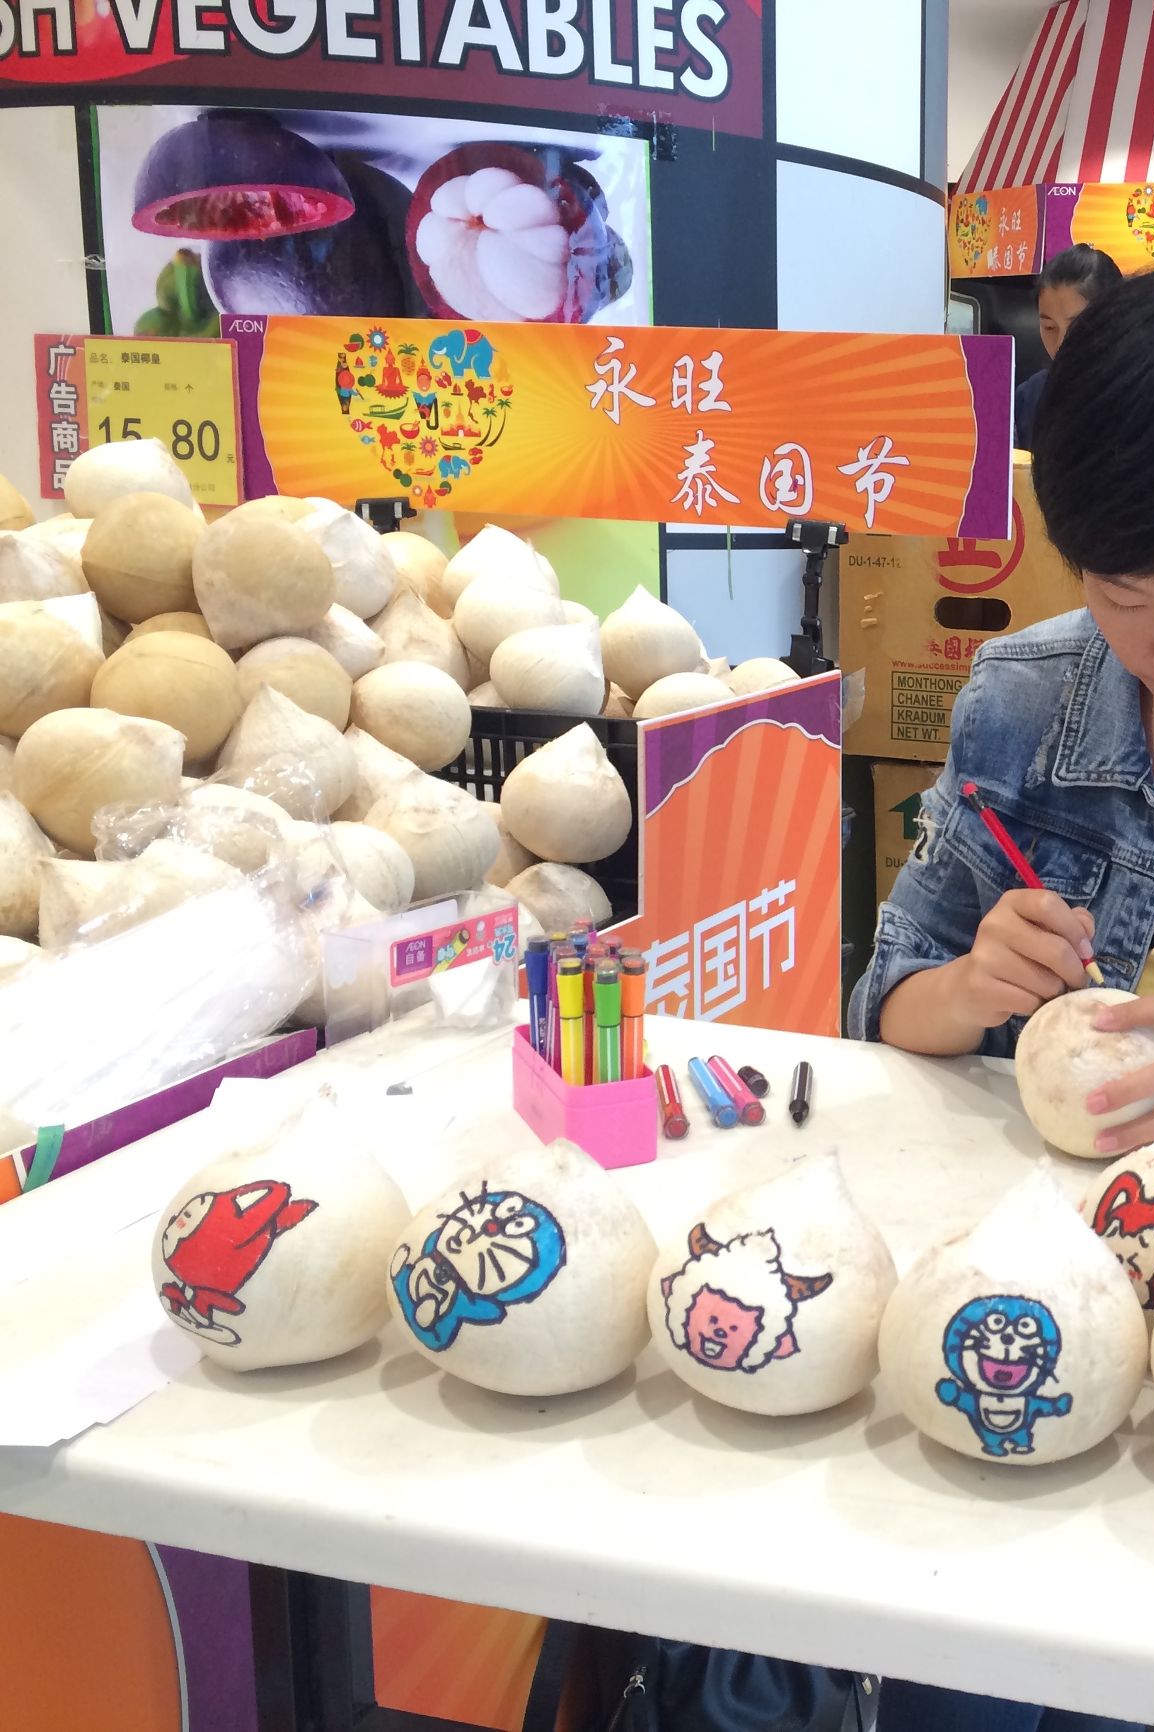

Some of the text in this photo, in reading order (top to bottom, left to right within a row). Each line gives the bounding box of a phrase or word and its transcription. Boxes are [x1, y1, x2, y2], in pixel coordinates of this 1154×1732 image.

[112, 0, 729, 99] VEGETABLES
[998, 207, 1022, 237] 永旺
[585, 336, 733, 425] 永旺
[670, 429, 911, 528] 泰国节
[897, 676, 962, 692] MONTHONG
[897, 692, 944, 708] CHANEE
[897, 709, 946, 725] KRADUM
[897, 725, 919, 738] NET
